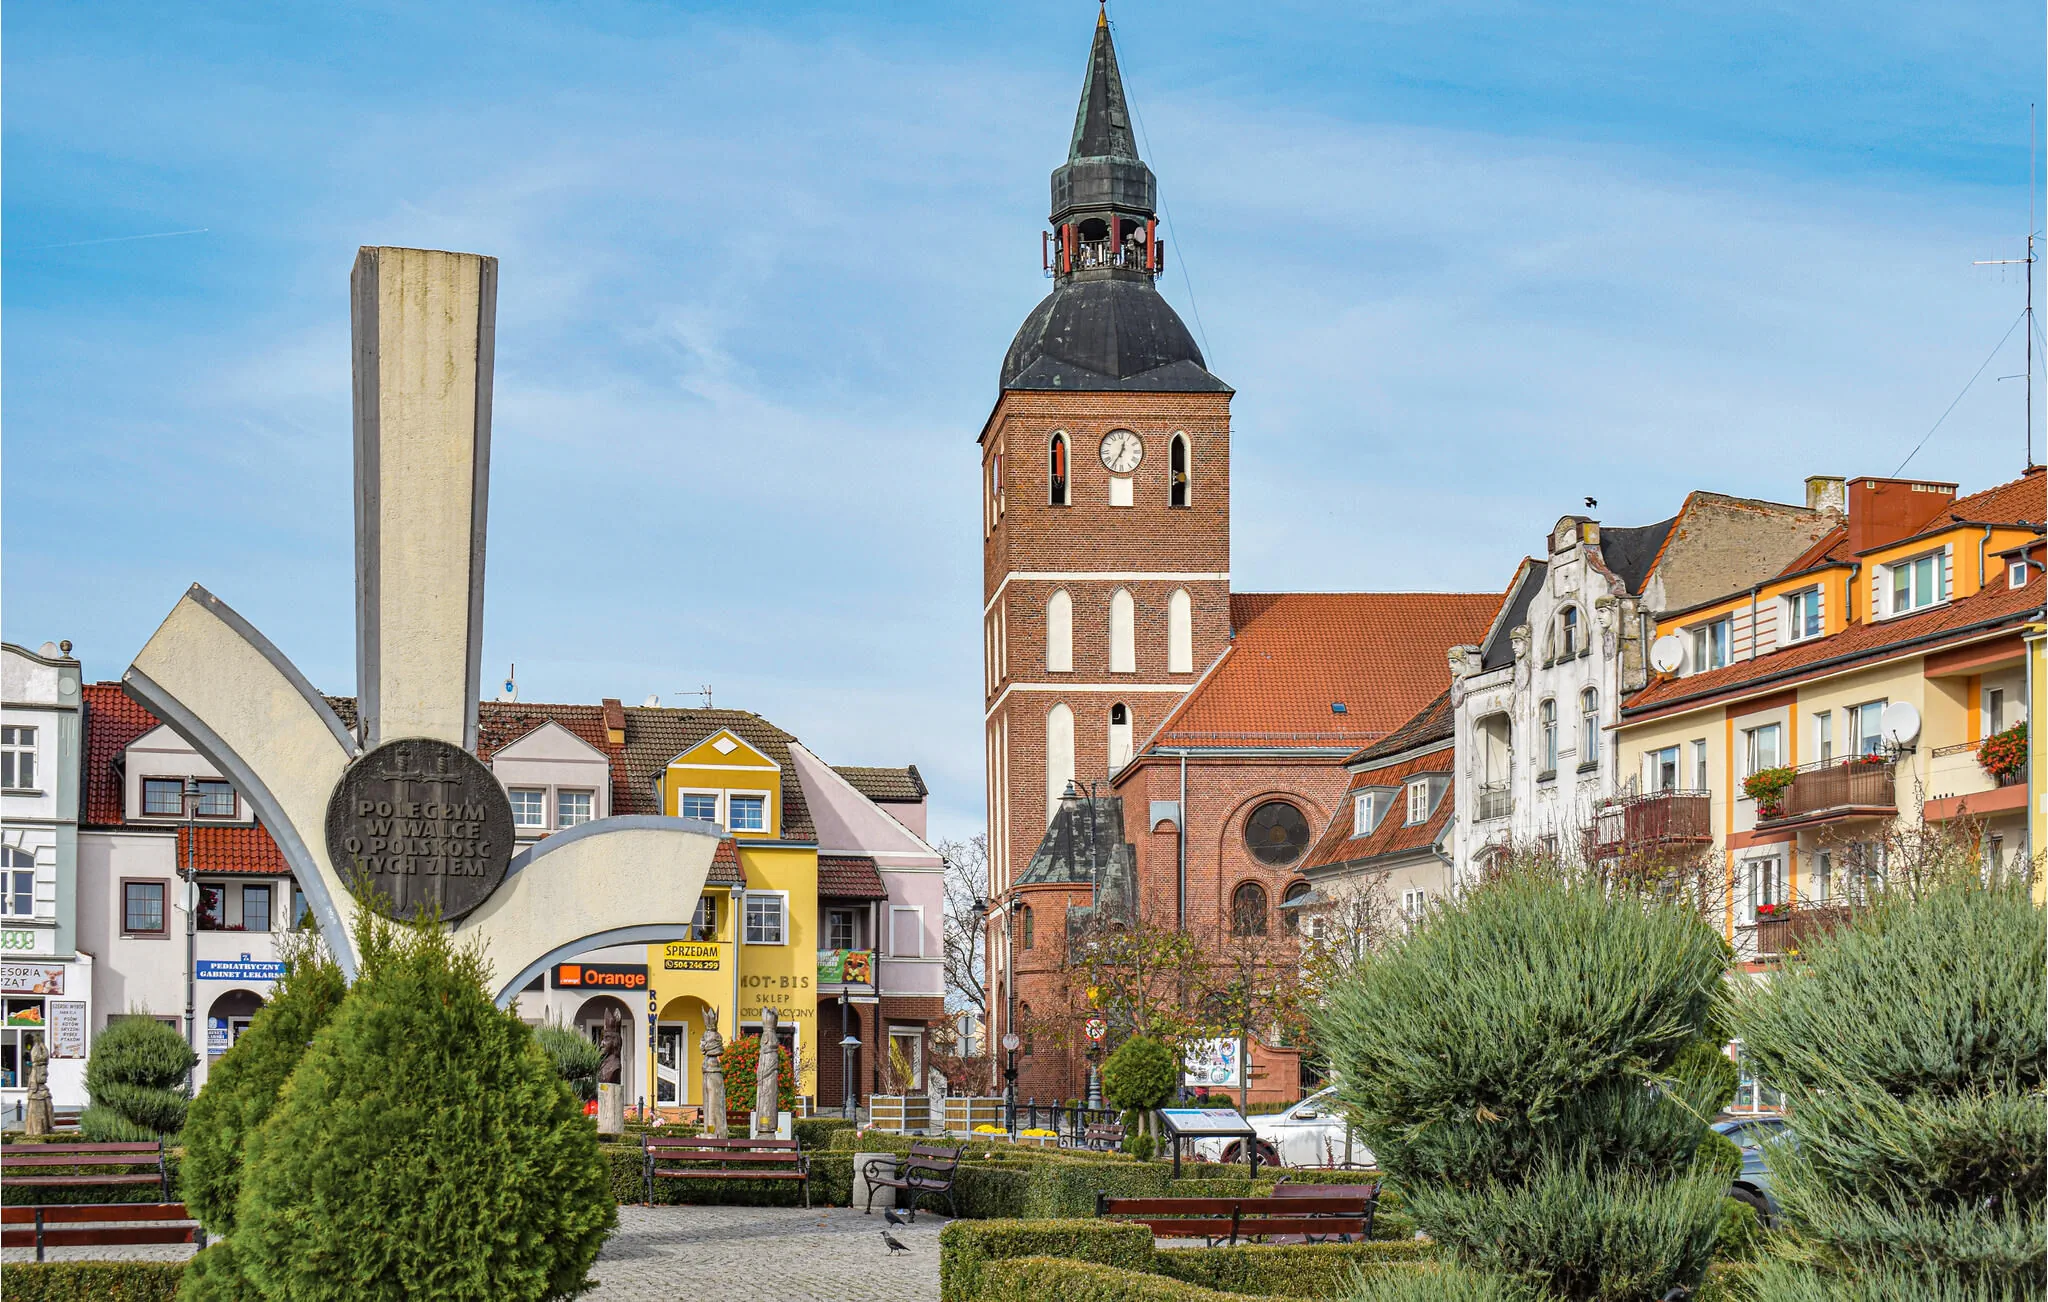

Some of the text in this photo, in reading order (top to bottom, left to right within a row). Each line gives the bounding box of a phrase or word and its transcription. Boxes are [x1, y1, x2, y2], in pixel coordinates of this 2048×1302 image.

[358, 802, 485, 821] POLEGŁYM
[367, 820, 480, 839] W WALCE
[345, 836, 492, 858] O POLSKOŚĆ
[359, 856, 485, 877] TYCH ZIEM
[666, 945, 718, 957] SPRZEDAM
[674, 961, 688, 969] 504
[704, 961, 719, 970] 299
[585, 969, 646, 988] Orange
[756, 993, 790, 1004] SKLEP
